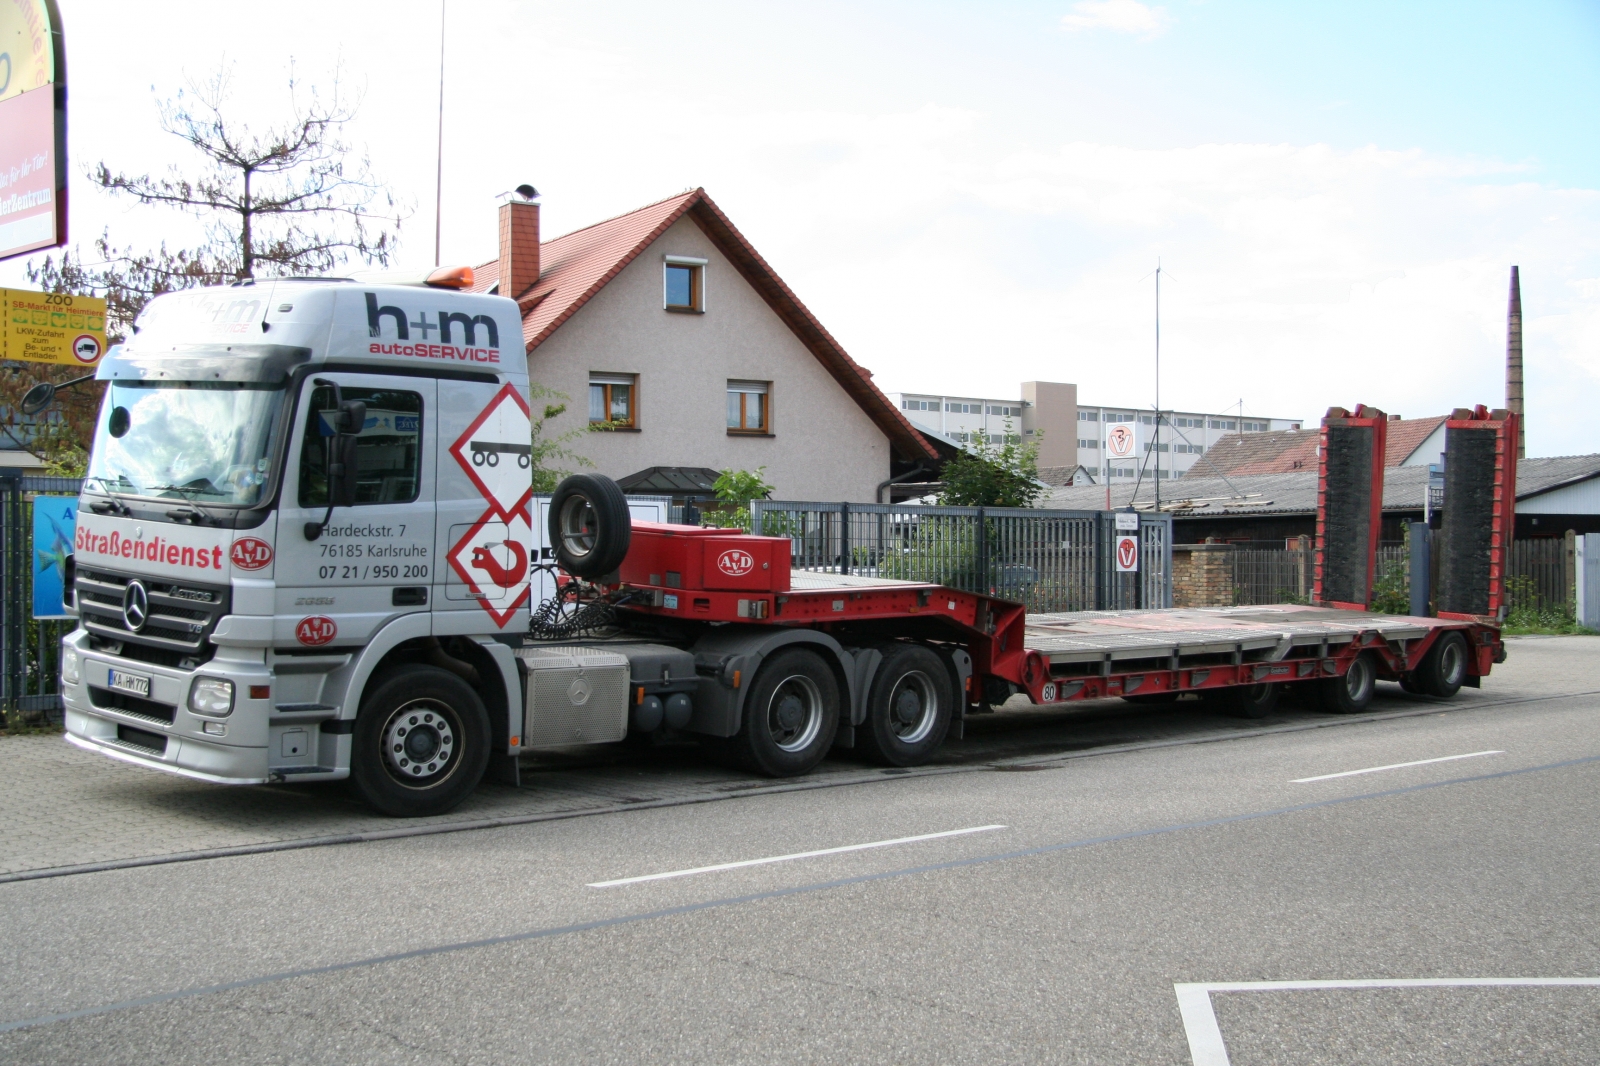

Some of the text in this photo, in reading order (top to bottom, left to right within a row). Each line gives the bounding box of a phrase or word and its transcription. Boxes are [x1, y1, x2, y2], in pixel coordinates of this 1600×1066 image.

[0, 187, 52, 216] ierZentrum
[45, 294, 73, 306] ZOO
[12, 300, 51, 312] SB-Markt
[66, 308, 104, 317] Heimtiere
[364, 292, 500, 348] h+m
[16, 327, 65, 339] LKW-Zufahrt
[25, 342, 56, 353] Be- und
[369, 343, 500, 363] autoSERVICE
[23, 350, 58, 360] Entladen
[320, 524, 406, 537] Hardeckstr. 7
[76, 526, 223, 569] Straßendienst
[320, 544, 427, 558] 76185 Karlsruhe
[319, 566, 337, 578] 07
[342, 566, 358, 578] 21
[373, 566, 398, 578] 950
[403, 565, 428, 578] 200
[114, 672, 122, 686] KA
[1044, 686, 1054, 700] 80
